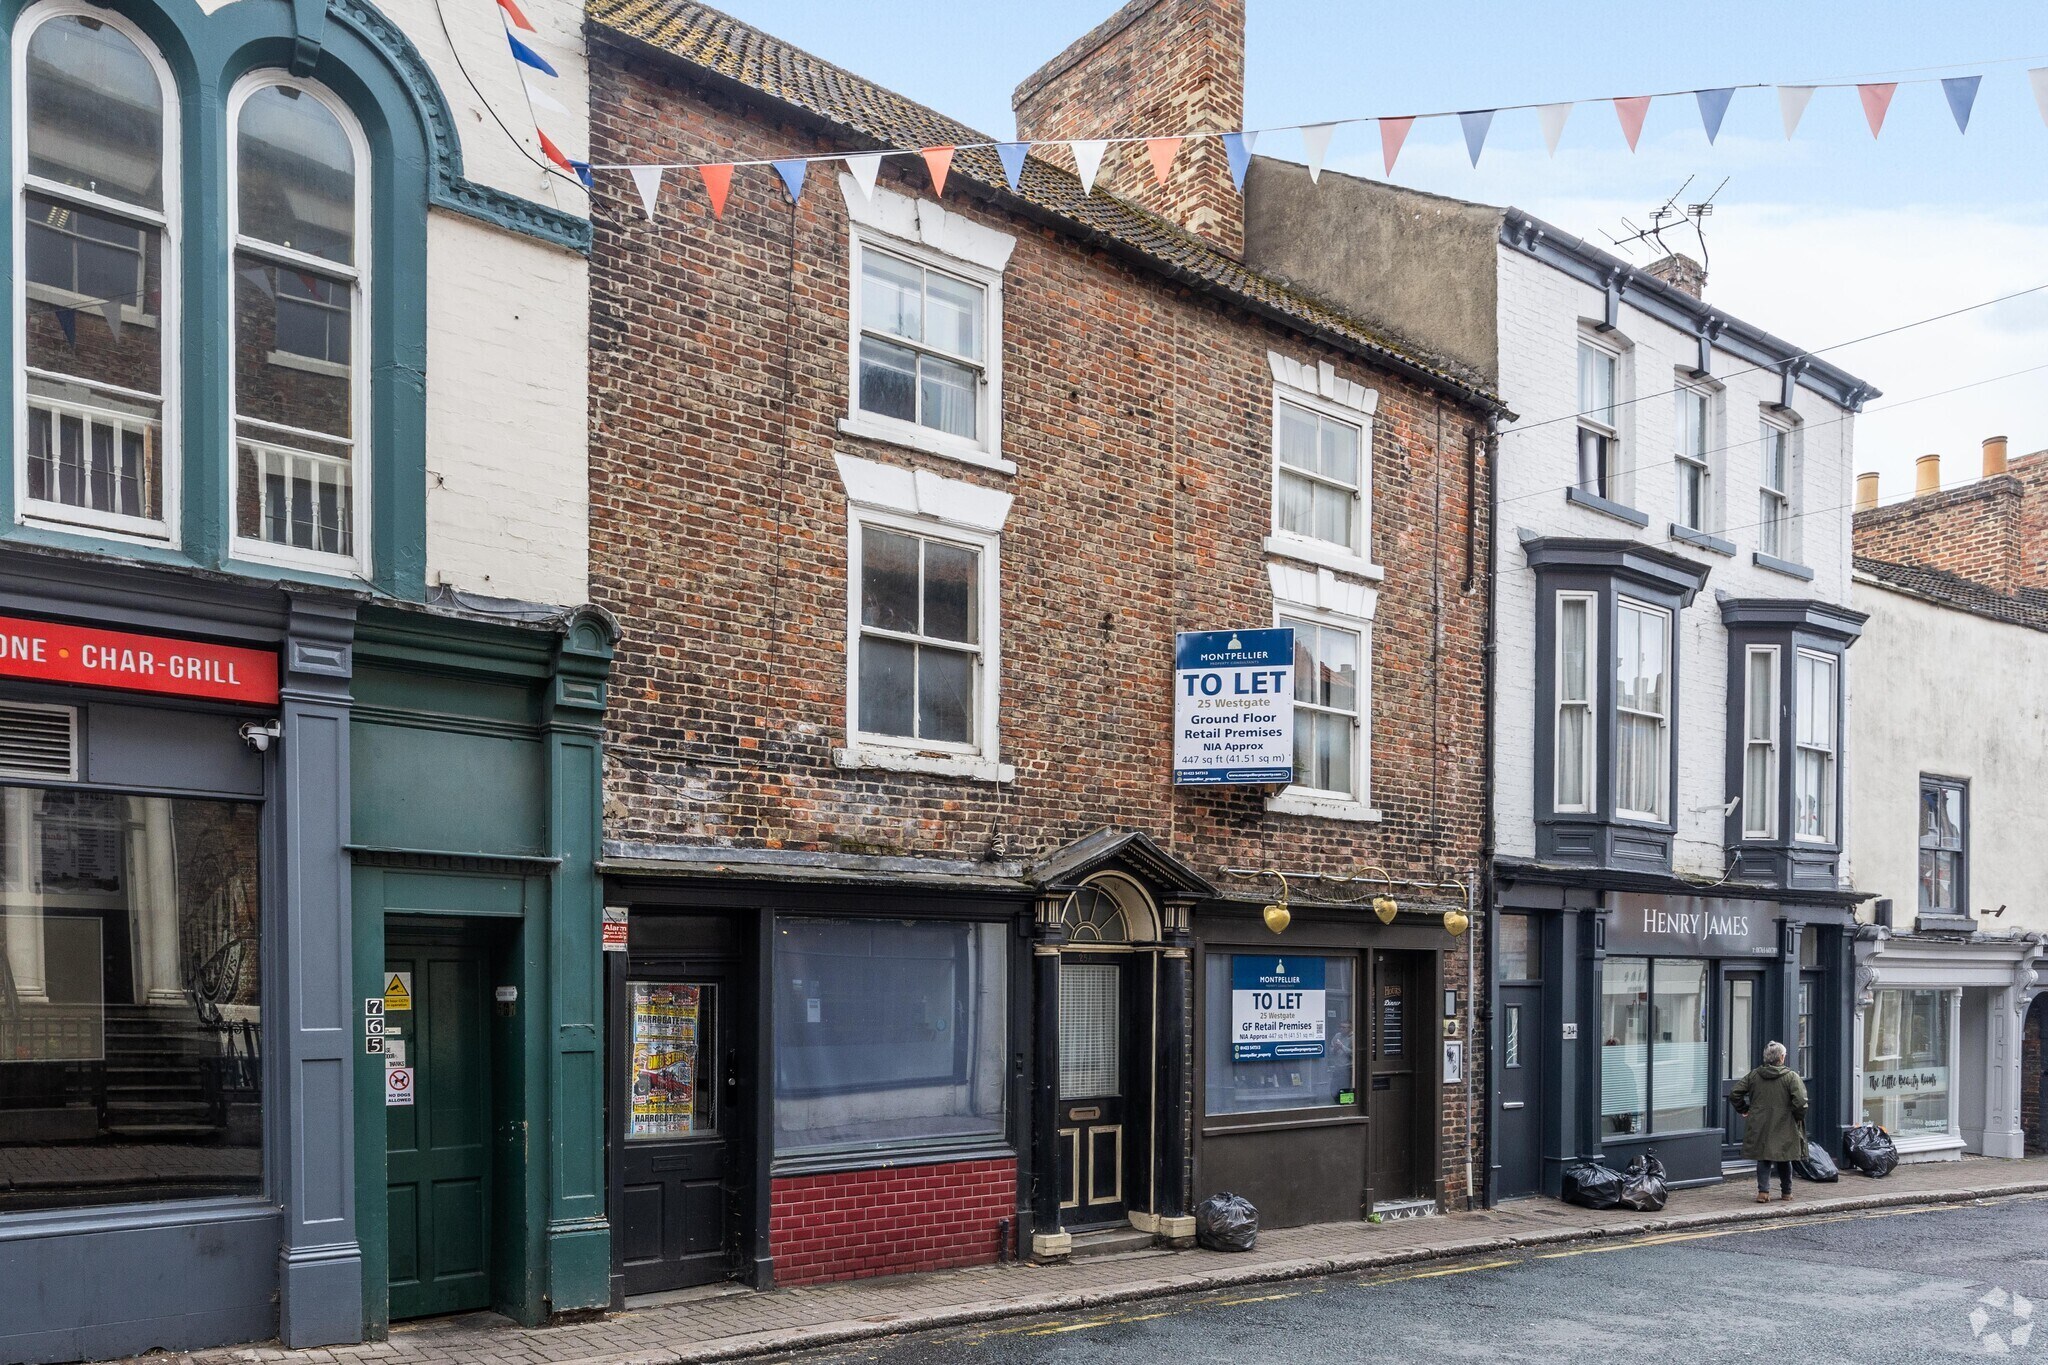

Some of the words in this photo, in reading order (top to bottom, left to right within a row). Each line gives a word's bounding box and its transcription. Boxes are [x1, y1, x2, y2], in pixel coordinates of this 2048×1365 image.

[1200, 651, 1269, 661] MONTPELLIER
[81, 643, 241, 685] CHAR-GRILL
[1182, 673, 1222, 696] TO
[1234, 671, 1287, 695] LET
[1197, 699, 1211, 709] 25
[1215, 698, 1271, 709] Westgate
[1191, 713, 1239, 725] Ground
[1243, 713, 1277, 723] Floor
[1184, 728, 1221, 739] Retail
[1225, 727, 1283, 738] Premises
[1203, 743, 1222, 751] NIA
[1224, 742, 1264, 752] Approx
[1181, 755, 1199, 764] 447
[1202, 757, 1213, 765] sq
[1216, 755, 1223, 763] ft
[1225, 754, 1255, 764] (41.51
[1258, 755, 1269, 764] sq
[1272, 753, 1285, 763] m)
[1643, 909, 1700, 934] HENRY
[1702, 912, 1749, 940] JAMES
[370, 1001, 380, 1014] 7
[1253, 993, 1272, 1010] TO
[1278, 993, 1303, 1009] LET
[638, 1015, 680, 1025] HARROGATE
[1269, 1012, 1295, 1020] Westgate
[370, 1020, 381, 1033] 6
[1242, 1022, 1252, 1031] GF
[1254, 1022, 1277, 1031] Retail
[1279, 1021, 1312, 1030] Premises
[371, 1039, 381, 1052] 5
[1869, 1075, 1880, 1091] The
[635, 1114, 677, 1123] HARROGATE
